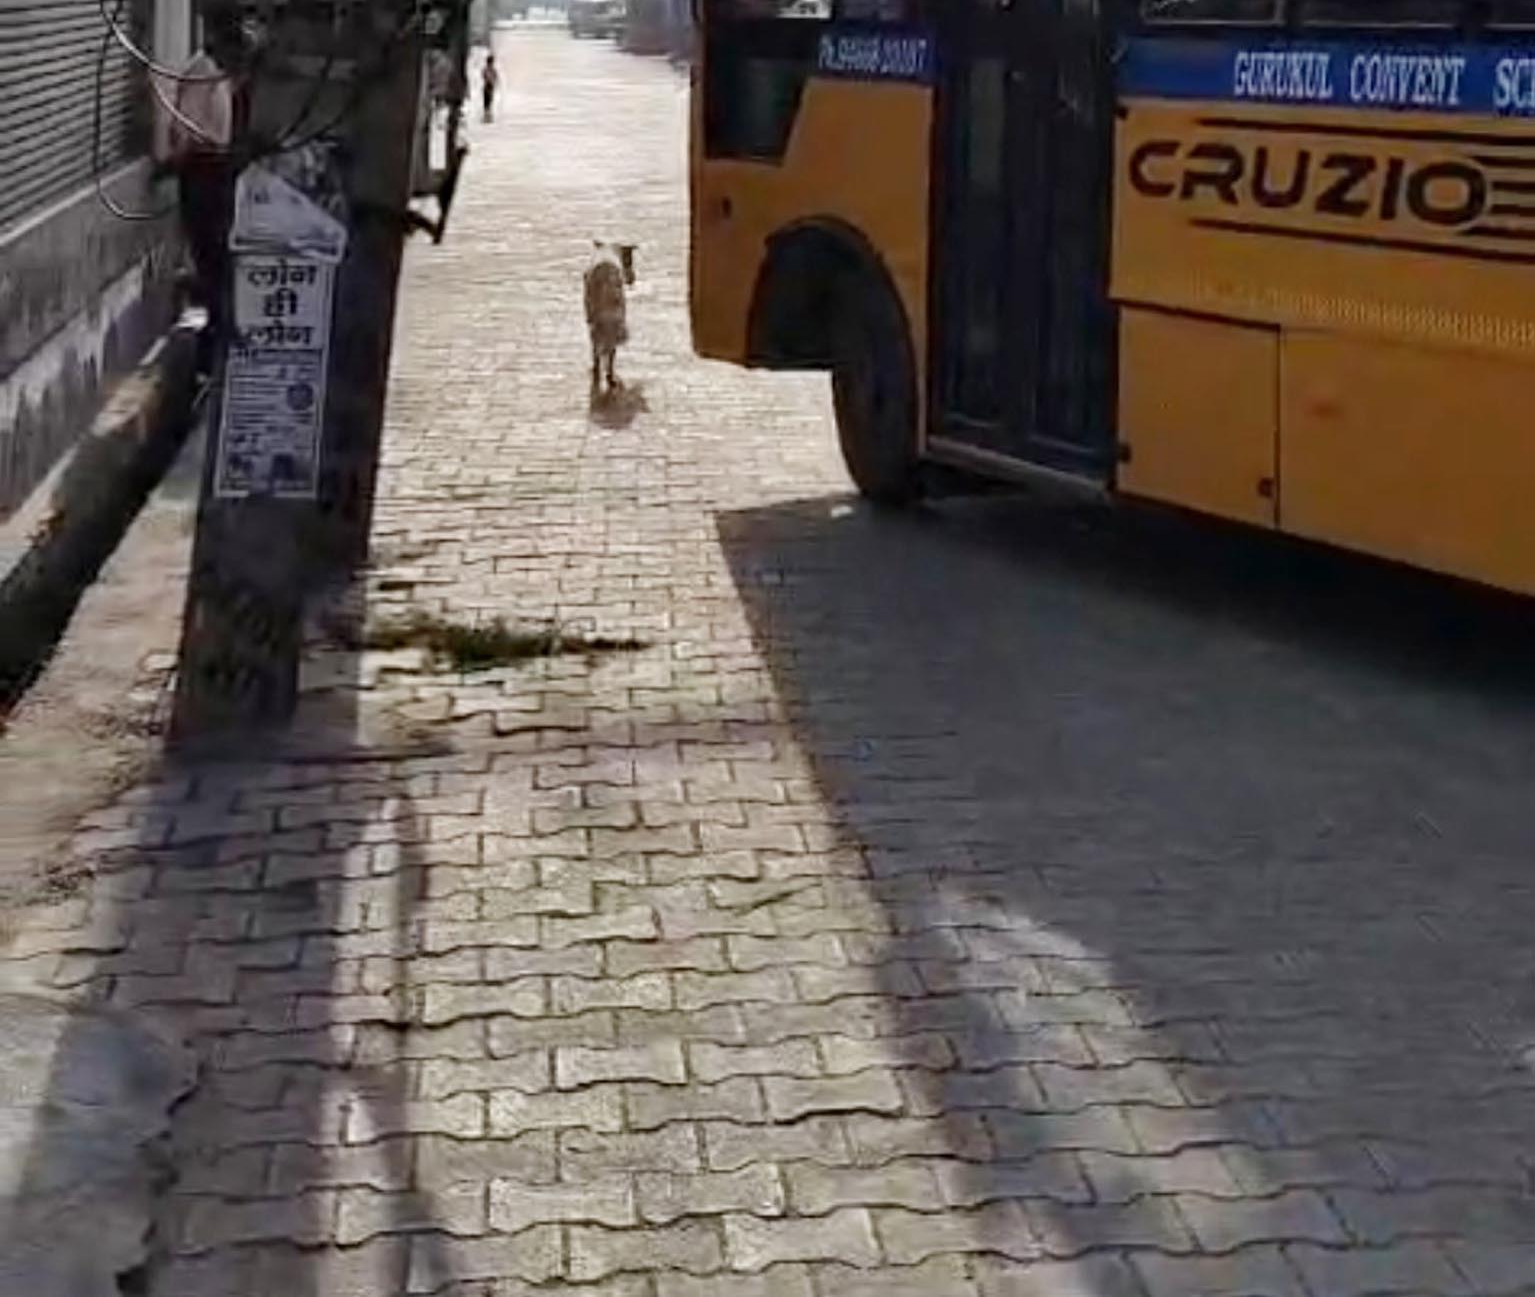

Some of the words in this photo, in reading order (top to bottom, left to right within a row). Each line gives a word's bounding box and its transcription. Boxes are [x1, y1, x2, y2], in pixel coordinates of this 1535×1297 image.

[1234, 51, 1333, 98] GURUKUL
[1350, 54, 1466, 106] CONVENT
[1129, 139, 1487, 227] CRUZIO
